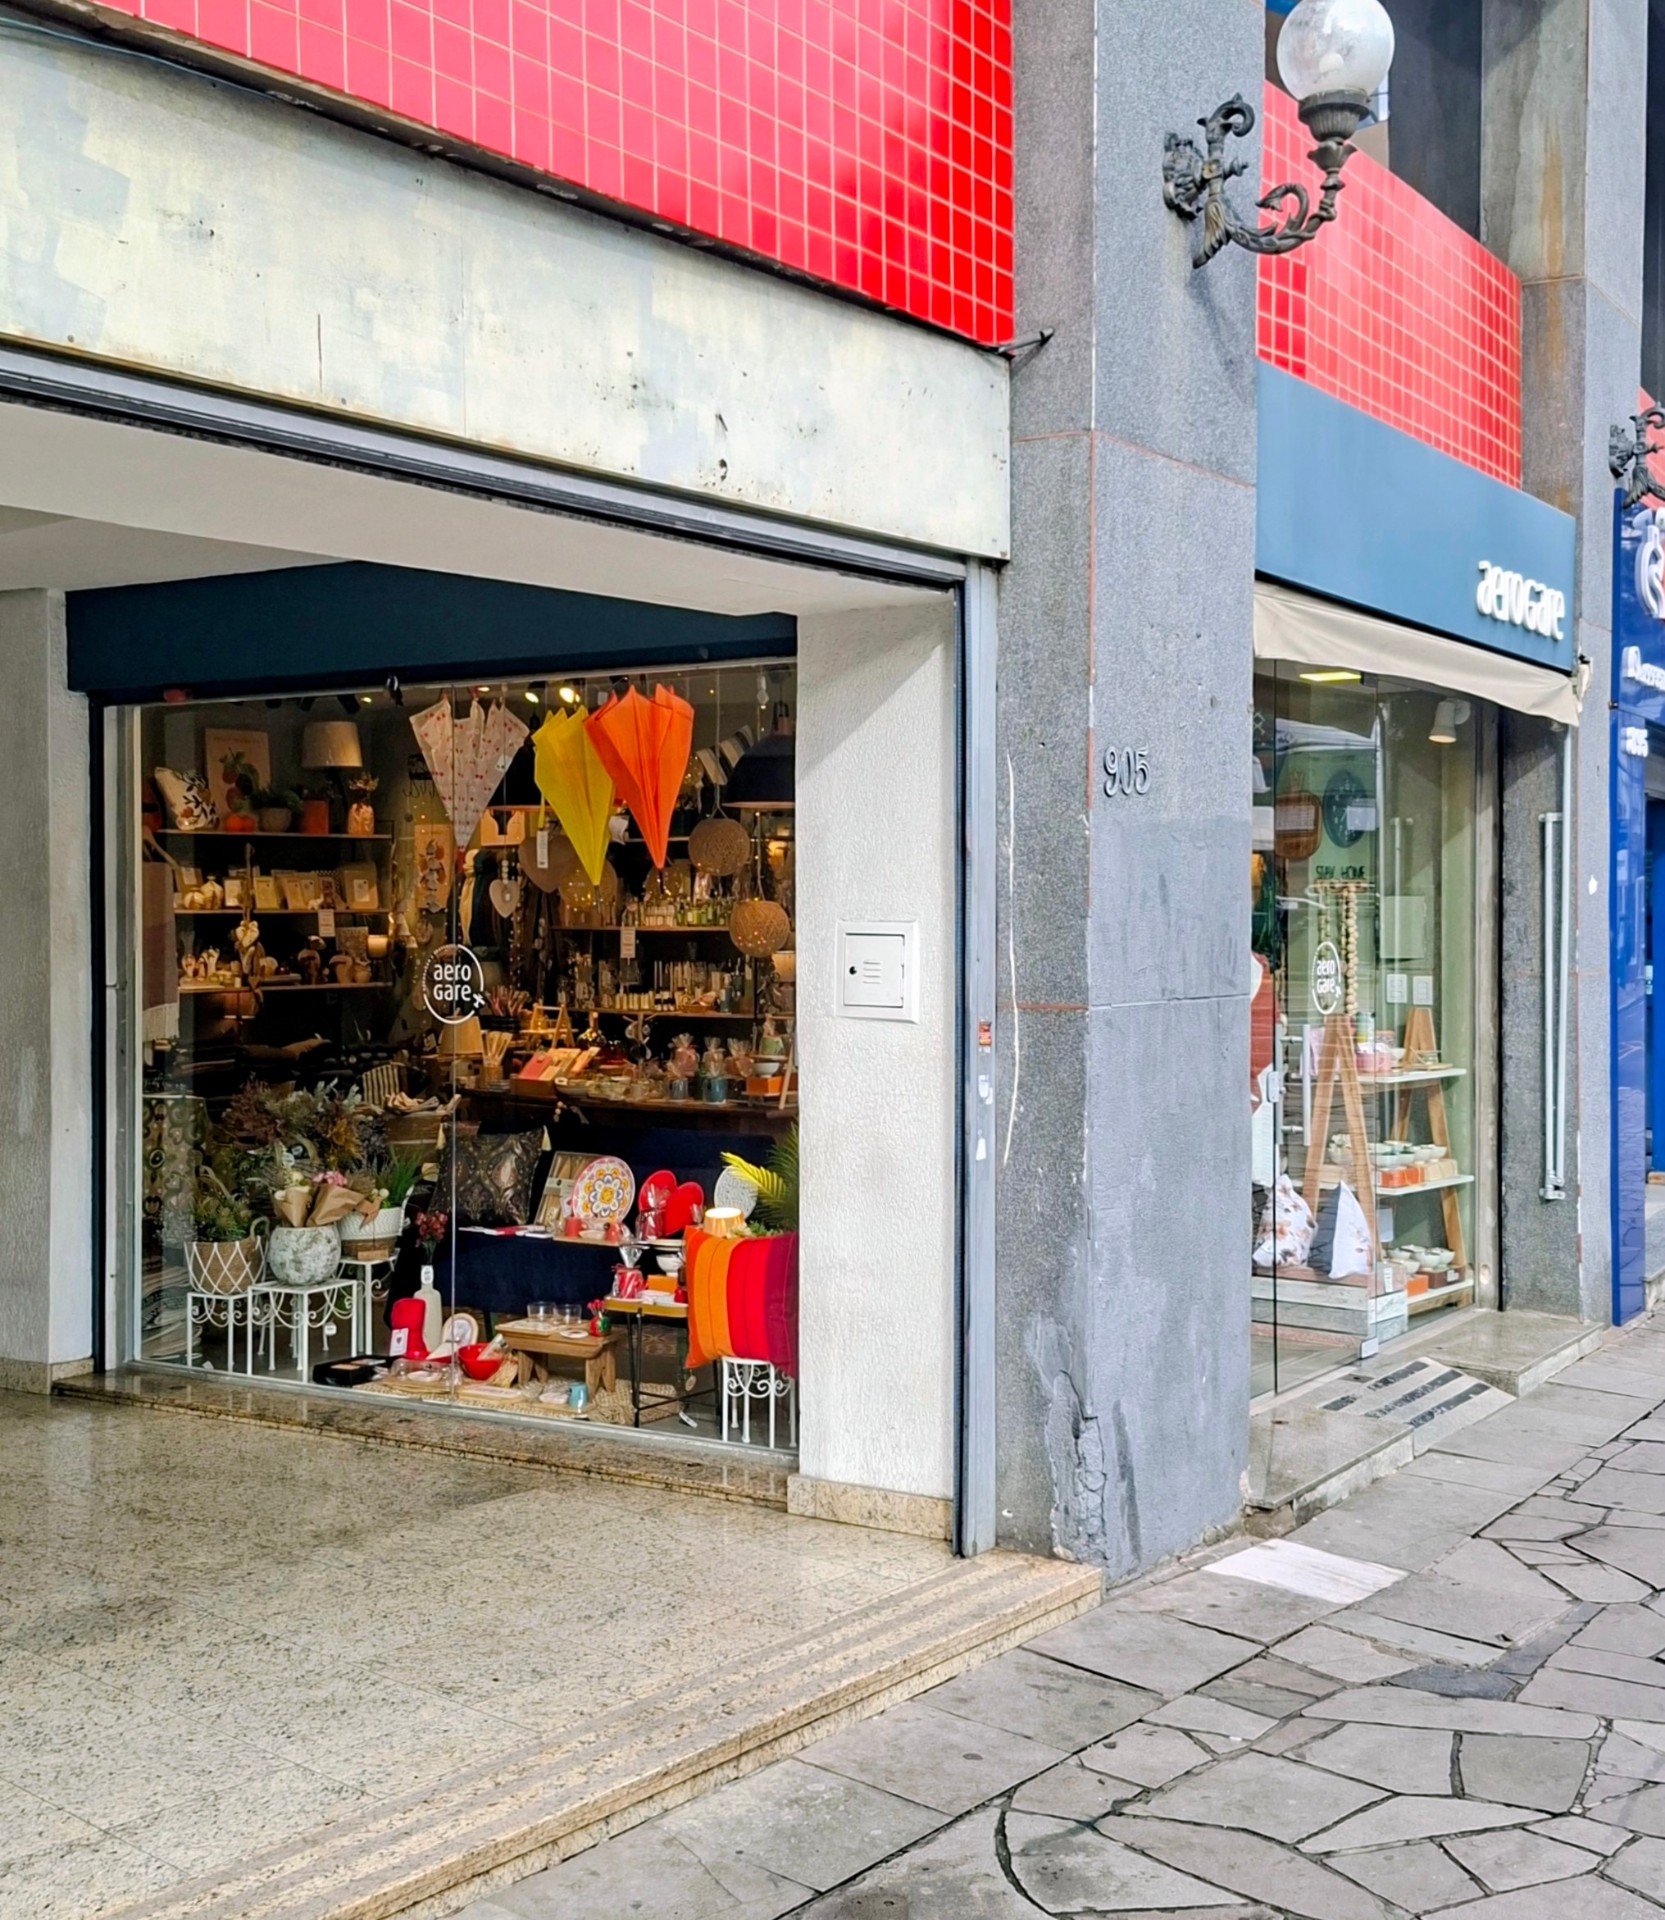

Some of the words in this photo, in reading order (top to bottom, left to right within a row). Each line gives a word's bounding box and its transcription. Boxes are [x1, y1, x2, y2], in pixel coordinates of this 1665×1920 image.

[1103, 745, 1151, 798] 905
[433, 963, 472, 982] aero
[1316, 960, 1336, 976] aero
